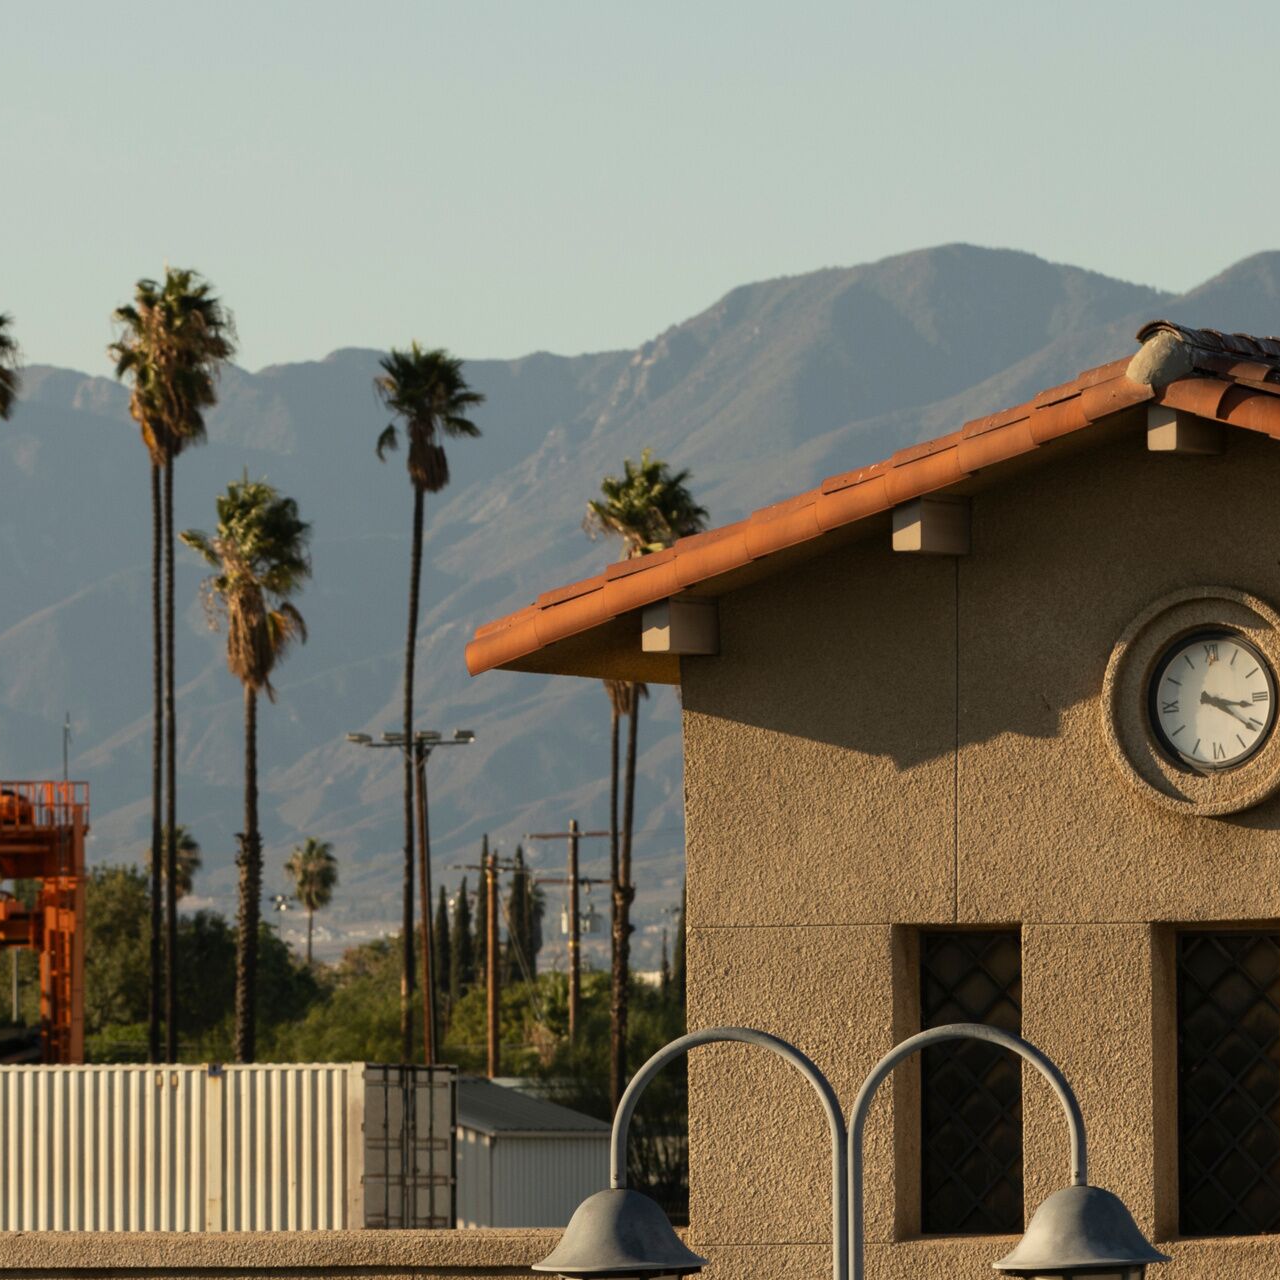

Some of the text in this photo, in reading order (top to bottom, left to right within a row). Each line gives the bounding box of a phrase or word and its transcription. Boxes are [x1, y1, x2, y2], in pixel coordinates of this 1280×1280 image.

[1252, 691, 1269, 702] III
[1162, 701, 1179, 714] IX
[1213, 742, 1226, 759] VI
